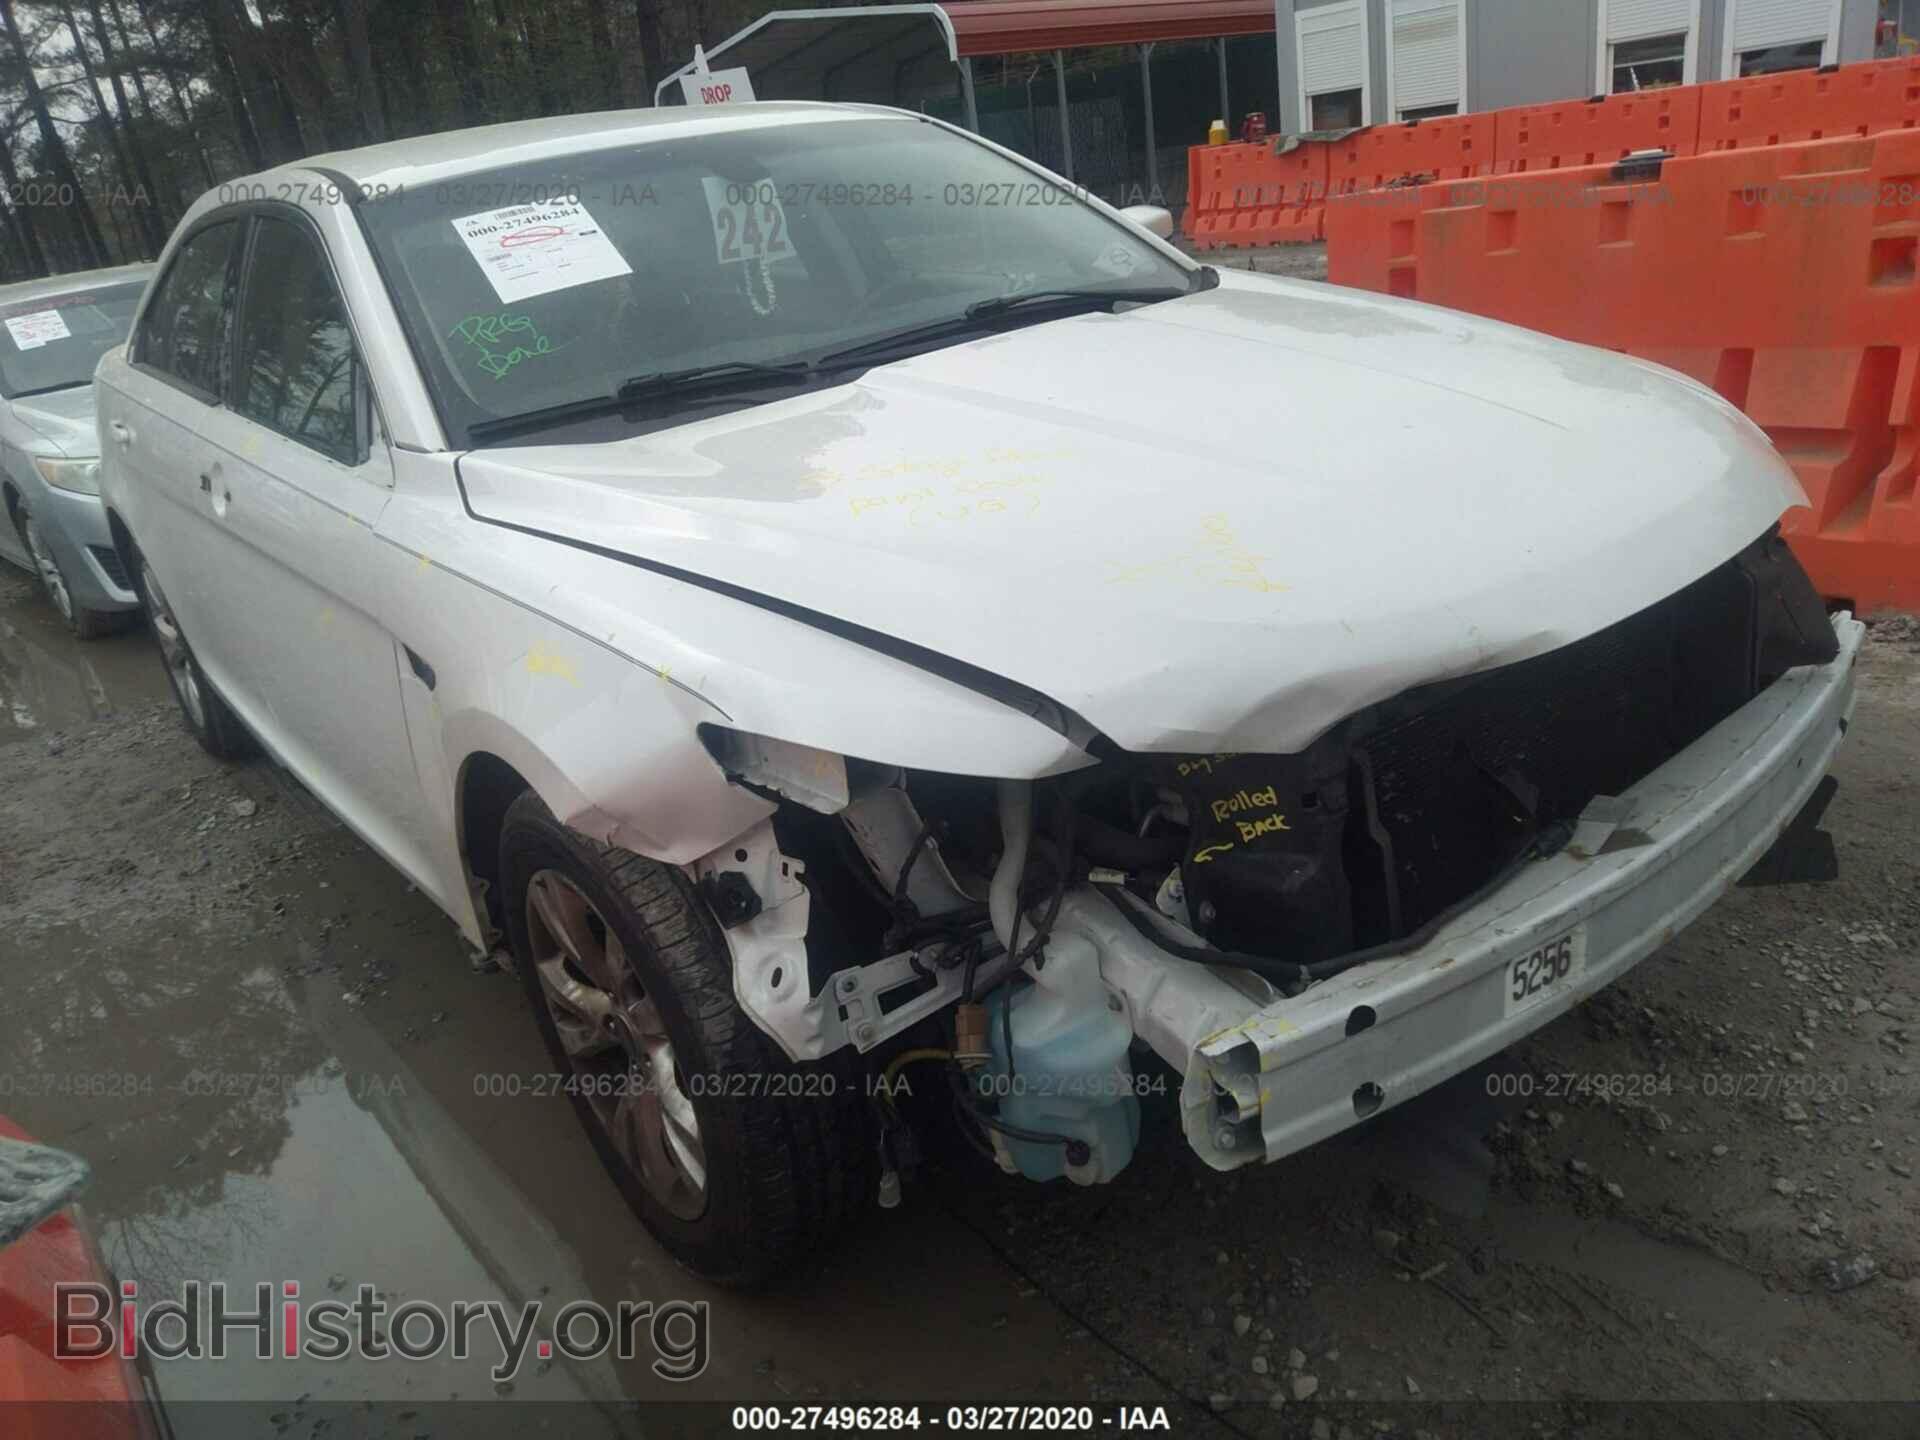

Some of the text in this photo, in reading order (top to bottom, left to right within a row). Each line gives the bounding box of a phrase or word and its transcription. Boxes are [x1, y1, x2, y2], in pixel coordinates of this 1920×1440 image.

[701, 84, 732, 104] DROP
[467, 206, 580, 240] 000-27496284
[716, 203, 788, 260] 242
[1211, 785, 1278, 823] Rolled
[1512, 935, 1571, 1001] 5256
